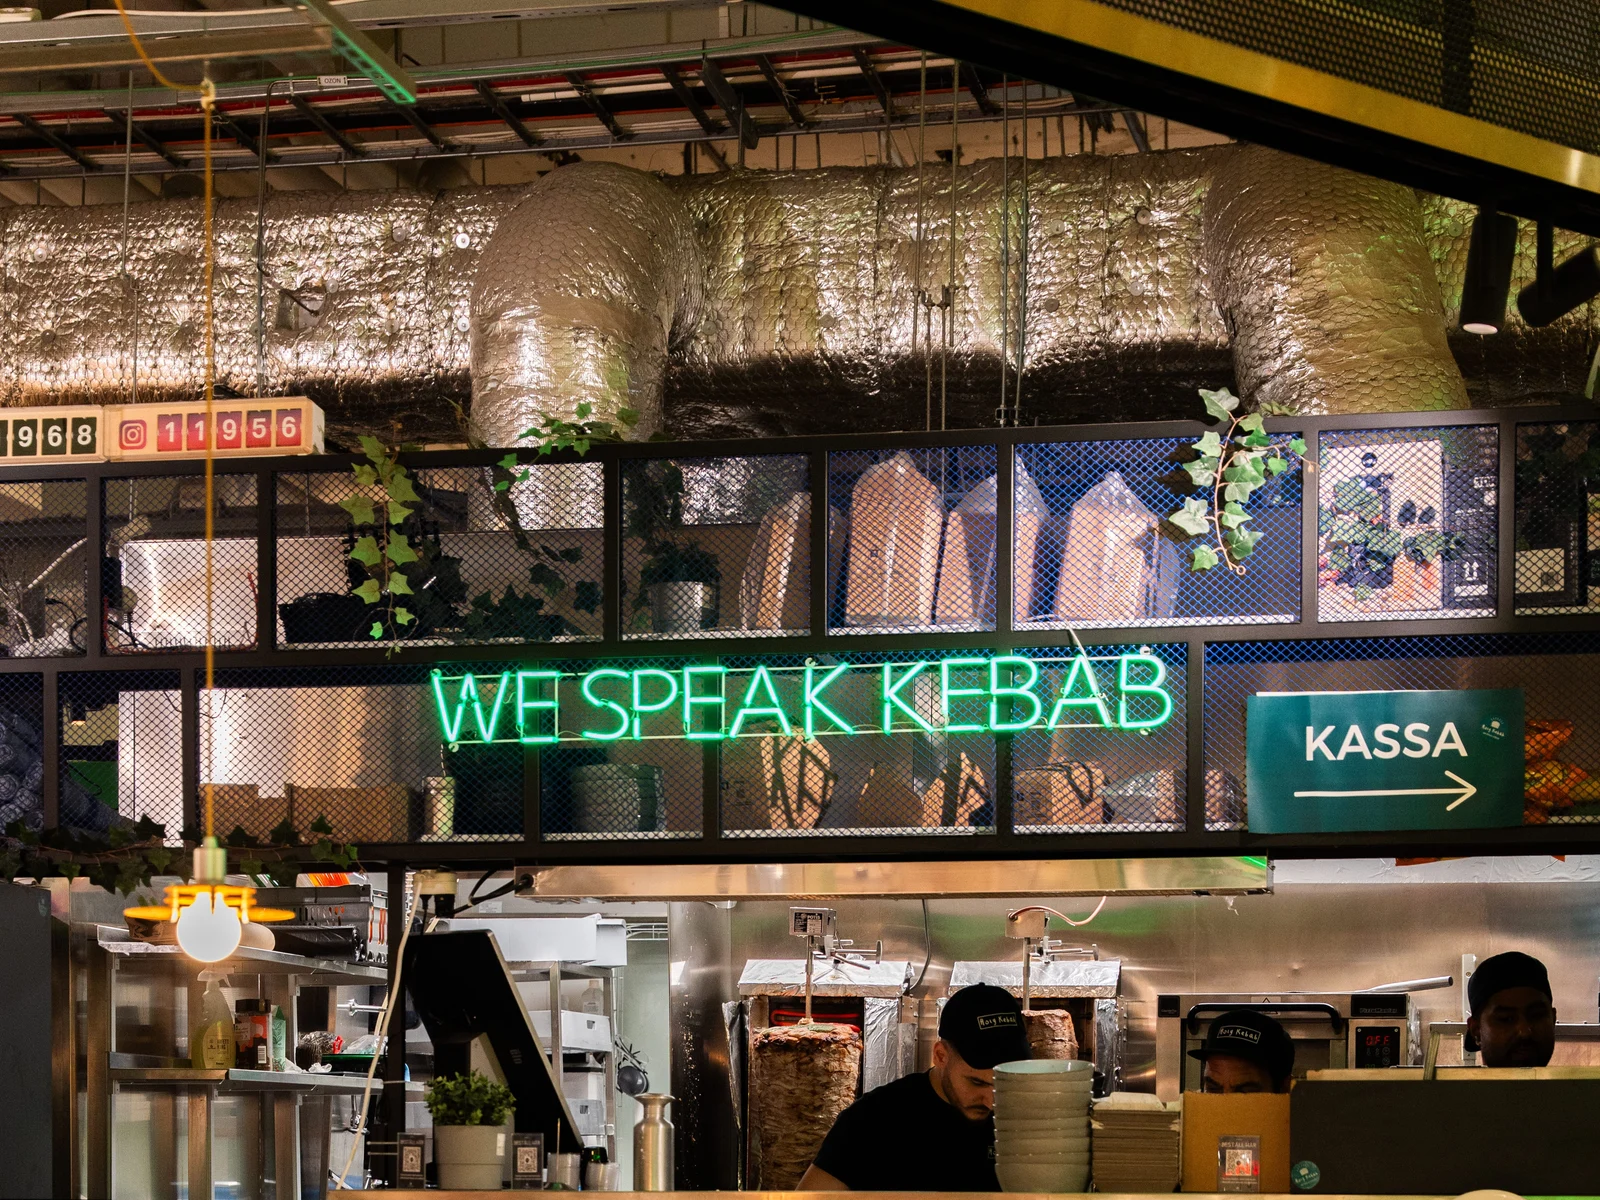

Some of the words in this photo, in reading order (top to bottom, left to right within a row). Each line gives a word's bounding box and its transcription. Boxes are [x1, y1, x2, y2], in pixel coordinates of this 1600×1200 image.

[164, 416, 297, 443] 11956
[431, 670, 560, 745] WE
[582, 661, 854, 742] SPEAK
[882, 653, 1174, 734] KEBAB
[1305, 721, 1468, 762] KASSA
[1365, 1035, 1390, 1046] OFF
